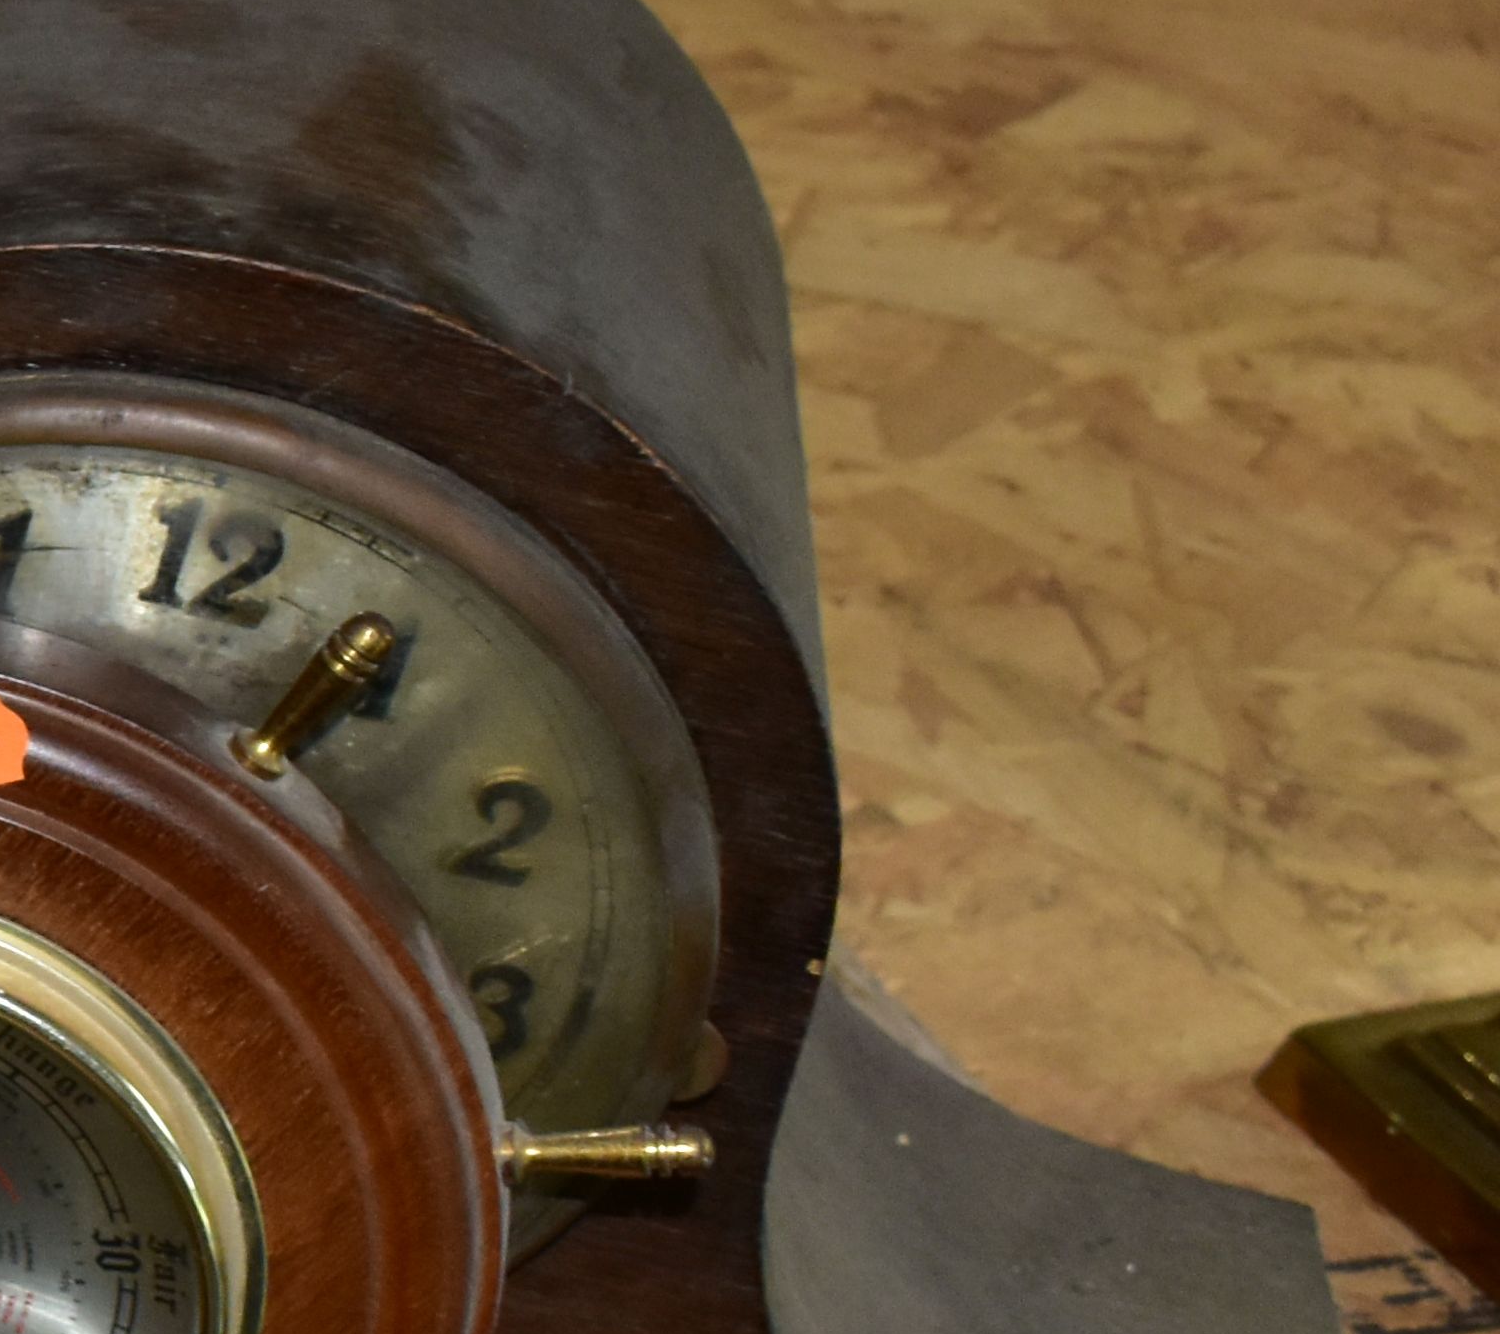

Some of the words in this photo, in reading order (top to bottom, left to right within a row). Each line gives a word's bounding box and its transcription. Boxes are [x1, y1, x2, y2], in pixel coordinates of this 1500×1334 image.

[137, 496, 288, 629] 12
[444, 779, 552, 888] 2
[92, 1227, 141, 1273] 30
